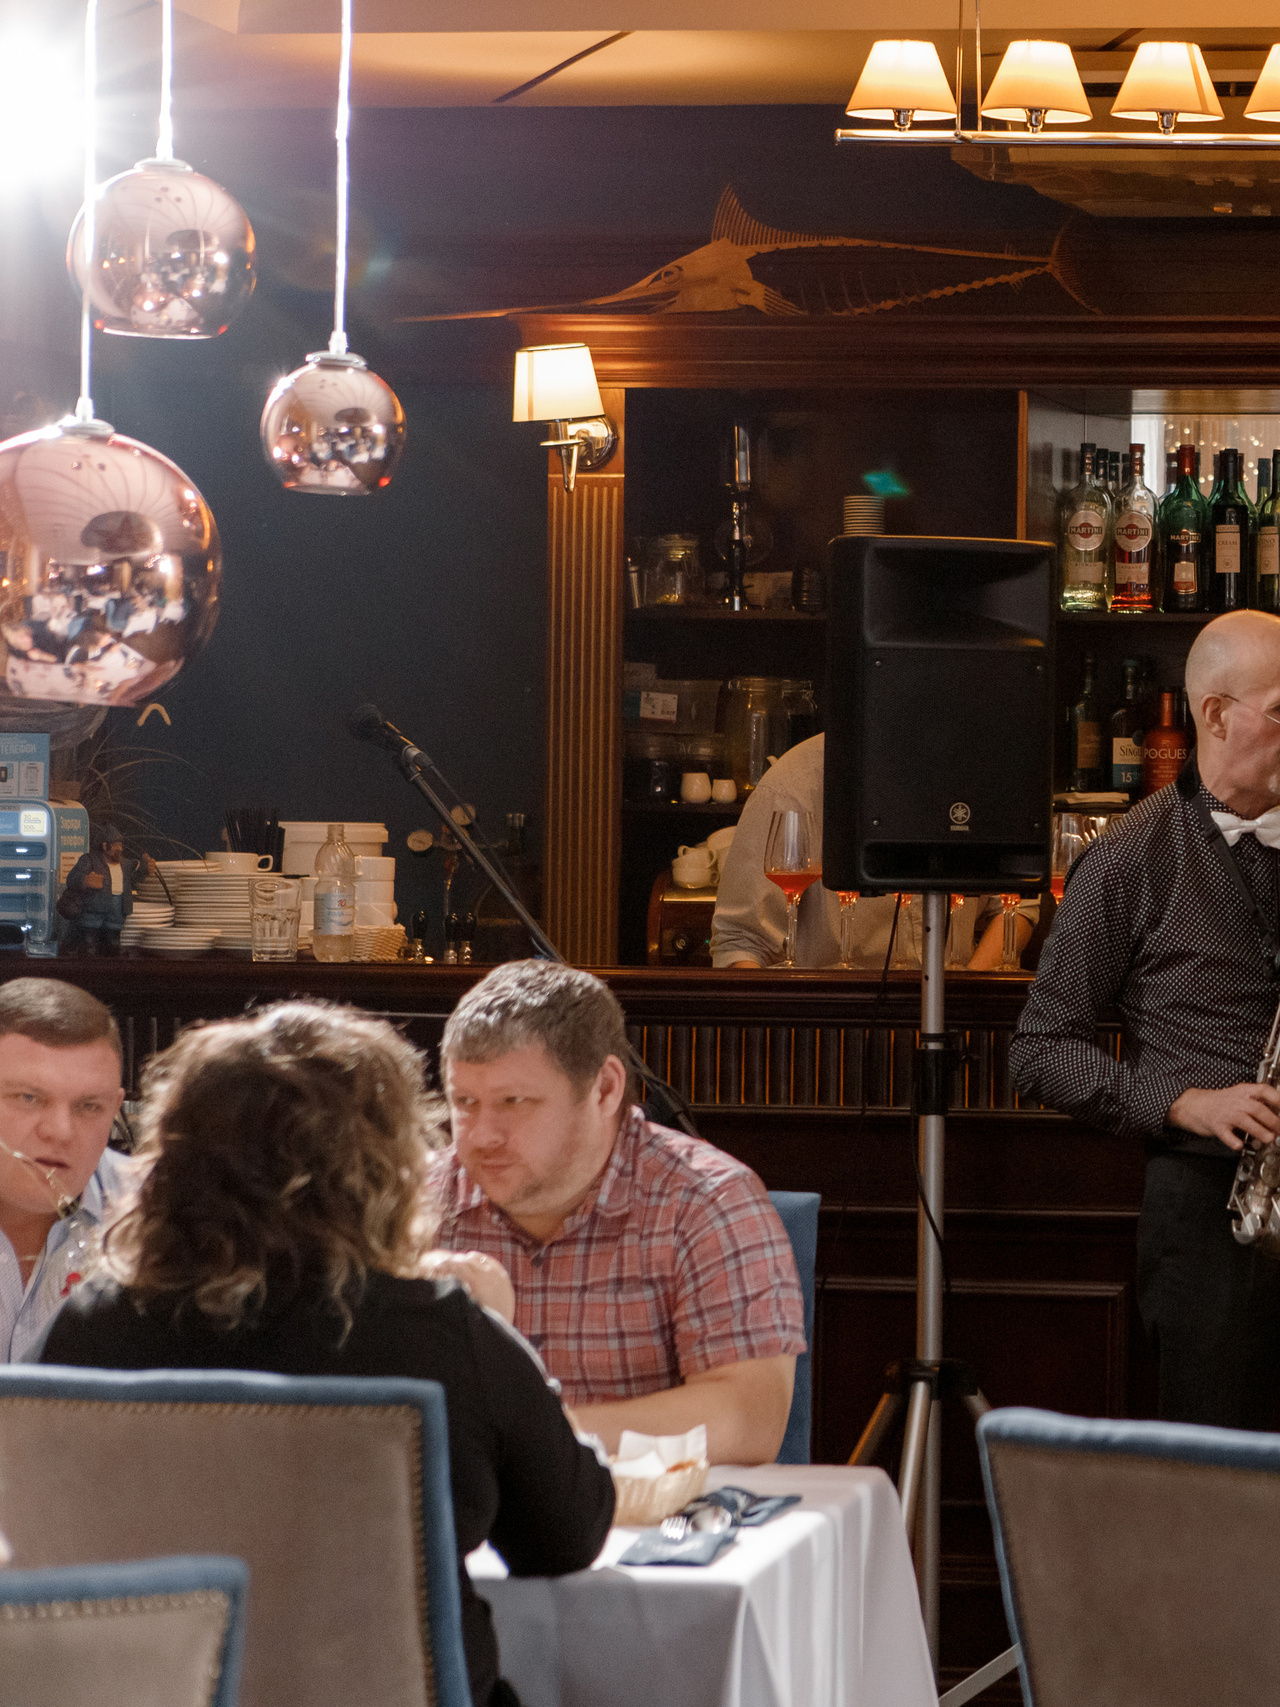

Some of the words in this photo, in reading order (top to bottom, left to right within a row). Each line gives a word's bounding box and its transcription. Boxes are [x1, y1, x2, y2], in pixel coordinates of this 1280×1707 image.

[1070, 526, 1102, 534] MARTINI
[1117, 527, 1149, 536] MARTINI
[1143, 748, 1187, 760] POGUES
